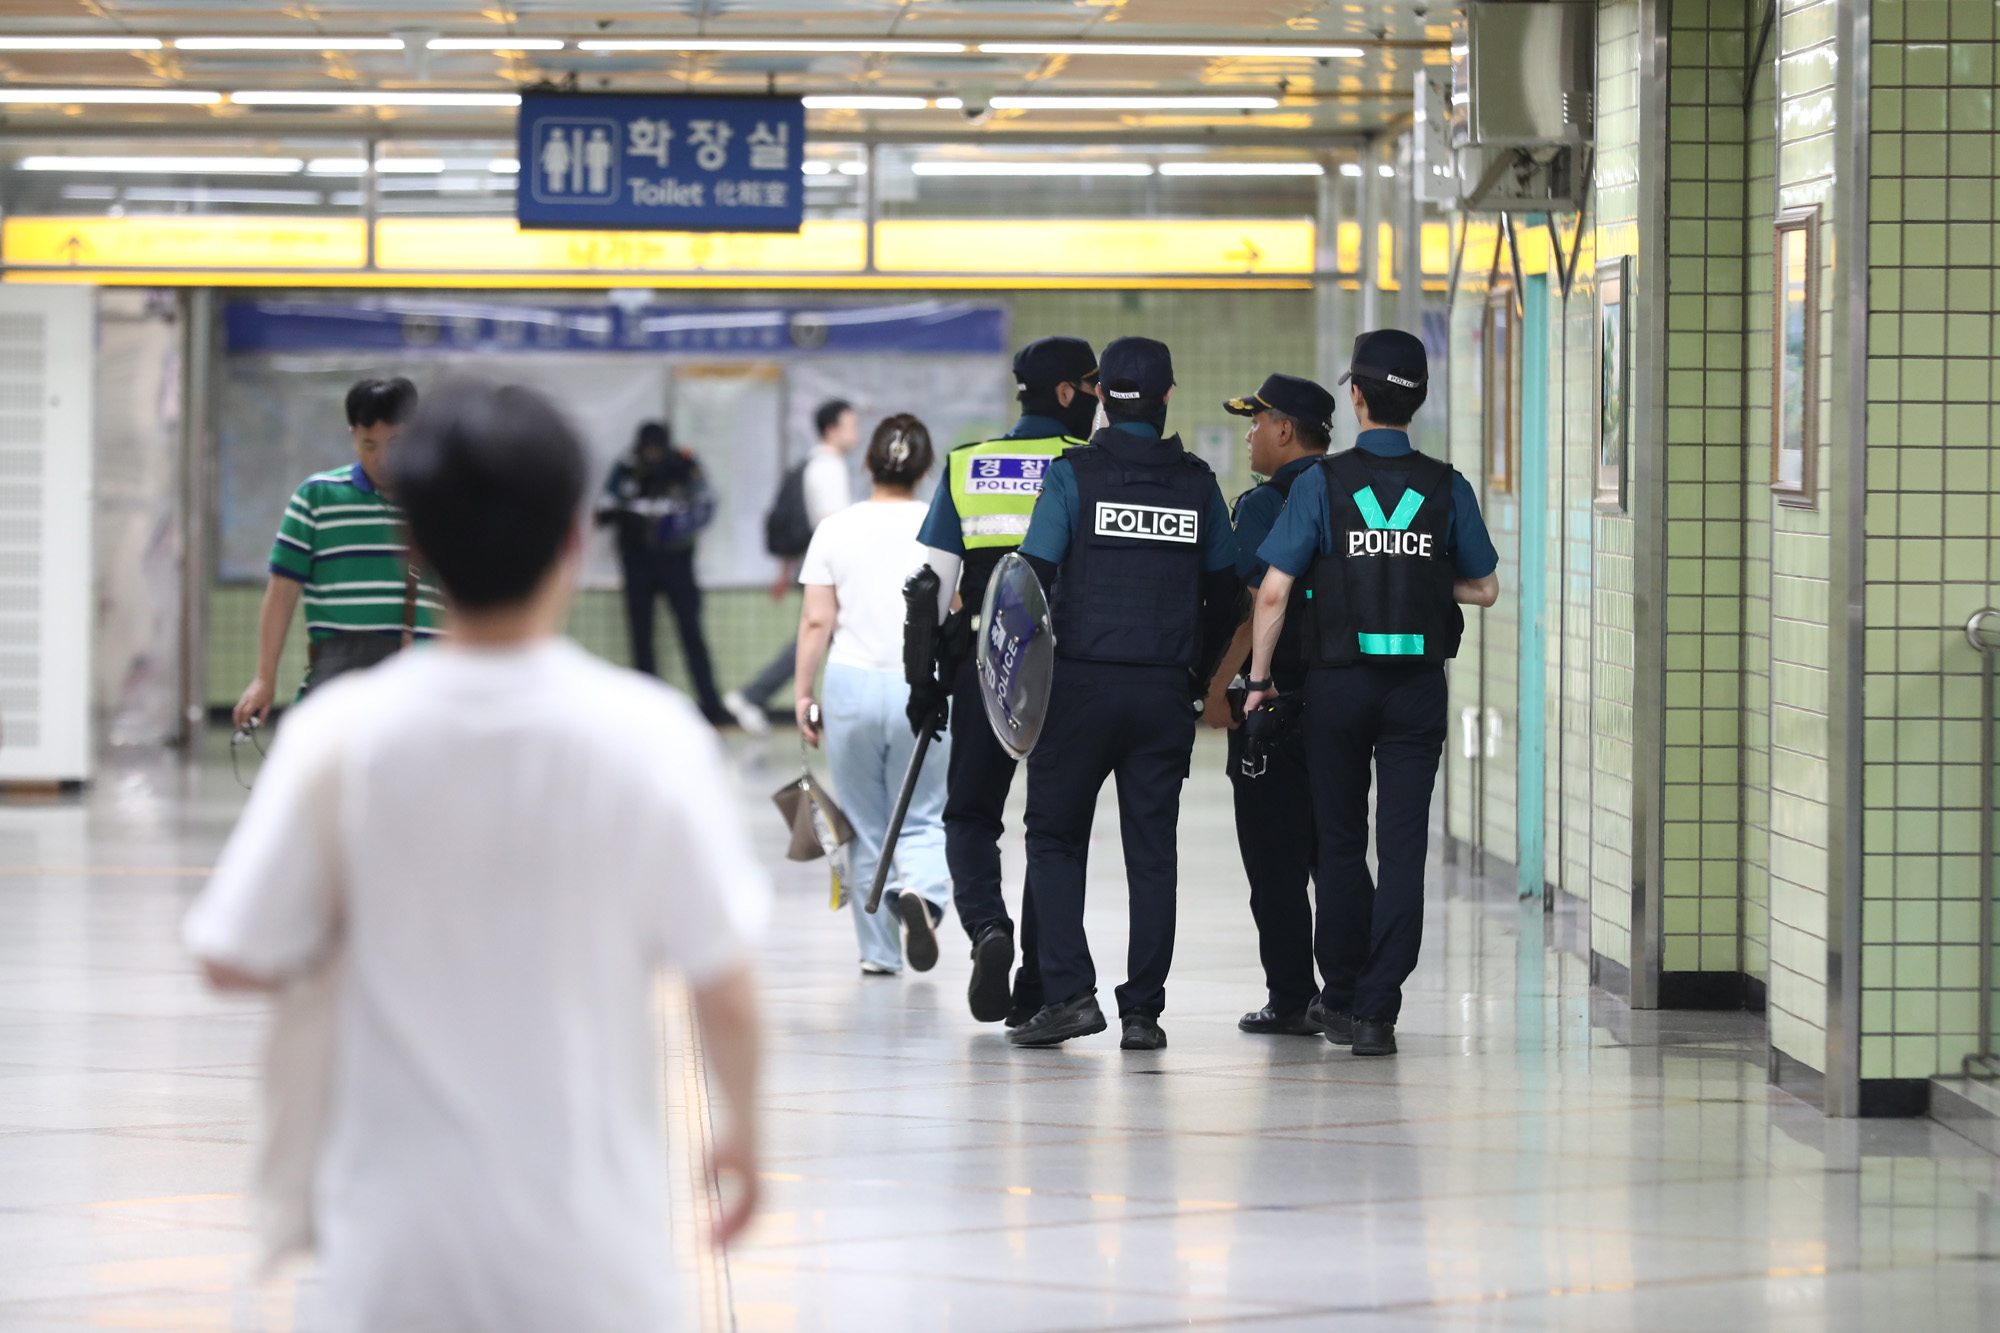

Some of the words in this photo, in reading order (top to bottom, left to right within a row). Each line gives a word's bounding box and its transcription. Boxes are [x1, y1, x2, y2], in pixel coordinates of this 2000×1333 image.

[627, 117, 789, 170] 화장실
[627, 177, 705, 207] Toilet
[978, 459, 1045, 479] 경찰
[976, 480, 1042, 491] POLICE
[1101, 508, 1194, 537] POLICE
[1349, 530, 1432, 556] POLICE
[997, 638, 1019, 710] POLICE
